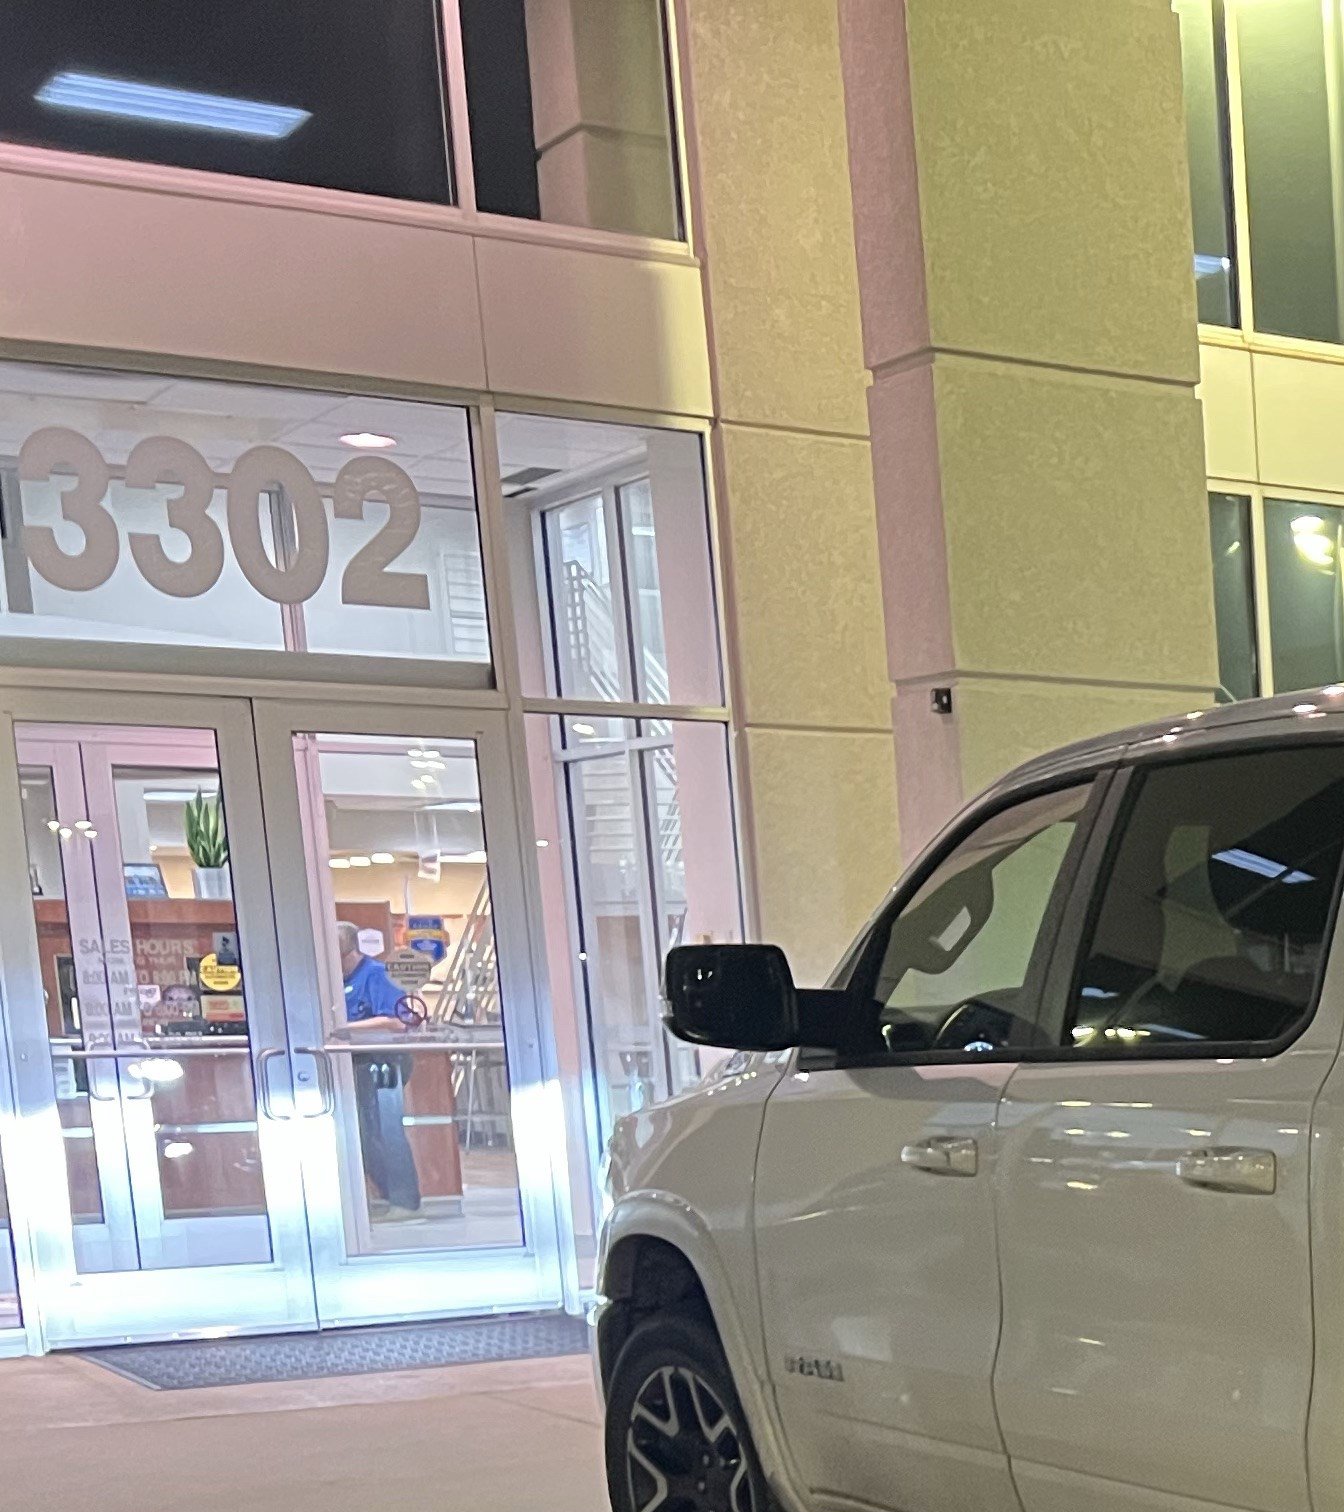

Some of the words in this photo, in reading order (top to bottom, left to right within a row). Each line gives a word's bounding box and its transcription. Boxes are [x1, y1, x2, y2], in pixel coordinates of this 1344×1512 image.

[18, 426, 430, 610] 3302
[80, 938, 130, 955] SALES
[135, 938, 195, 955] HOURS
